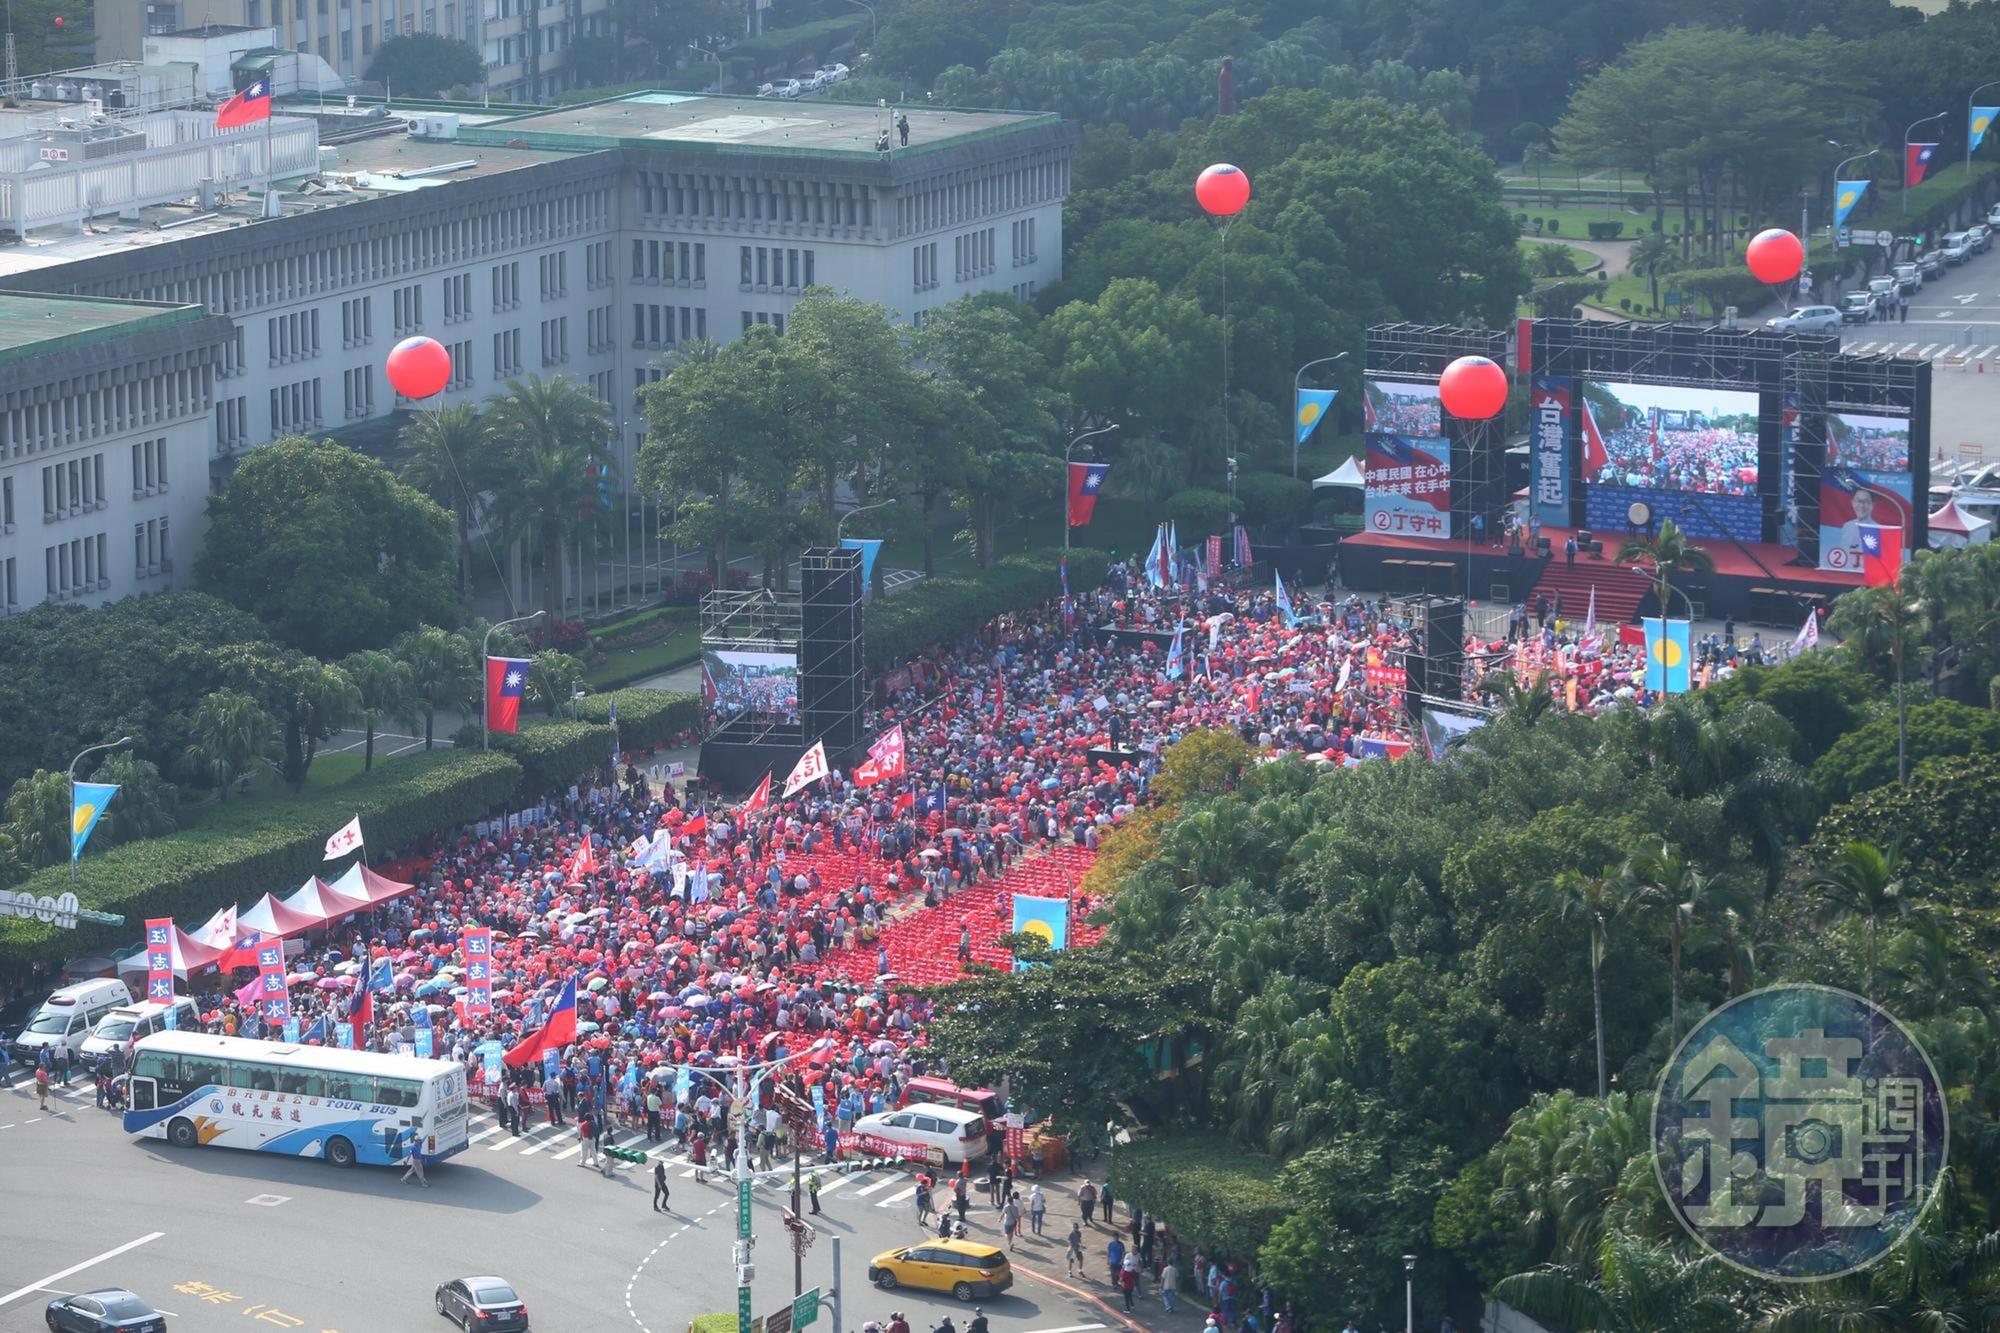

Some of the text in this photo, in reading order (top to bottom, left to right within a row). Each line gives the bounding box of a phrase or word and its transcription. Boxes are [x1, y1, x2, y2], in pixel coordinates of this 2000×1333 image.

[1538, 396, 1563, 504] 台灣奮起
[1365, 463, 1450, 482] 中華民國 在心中
[1365, 478, 1450, 498] 台北未來 在手中
[326, 1100, 398, 1115] TOUR BUS
